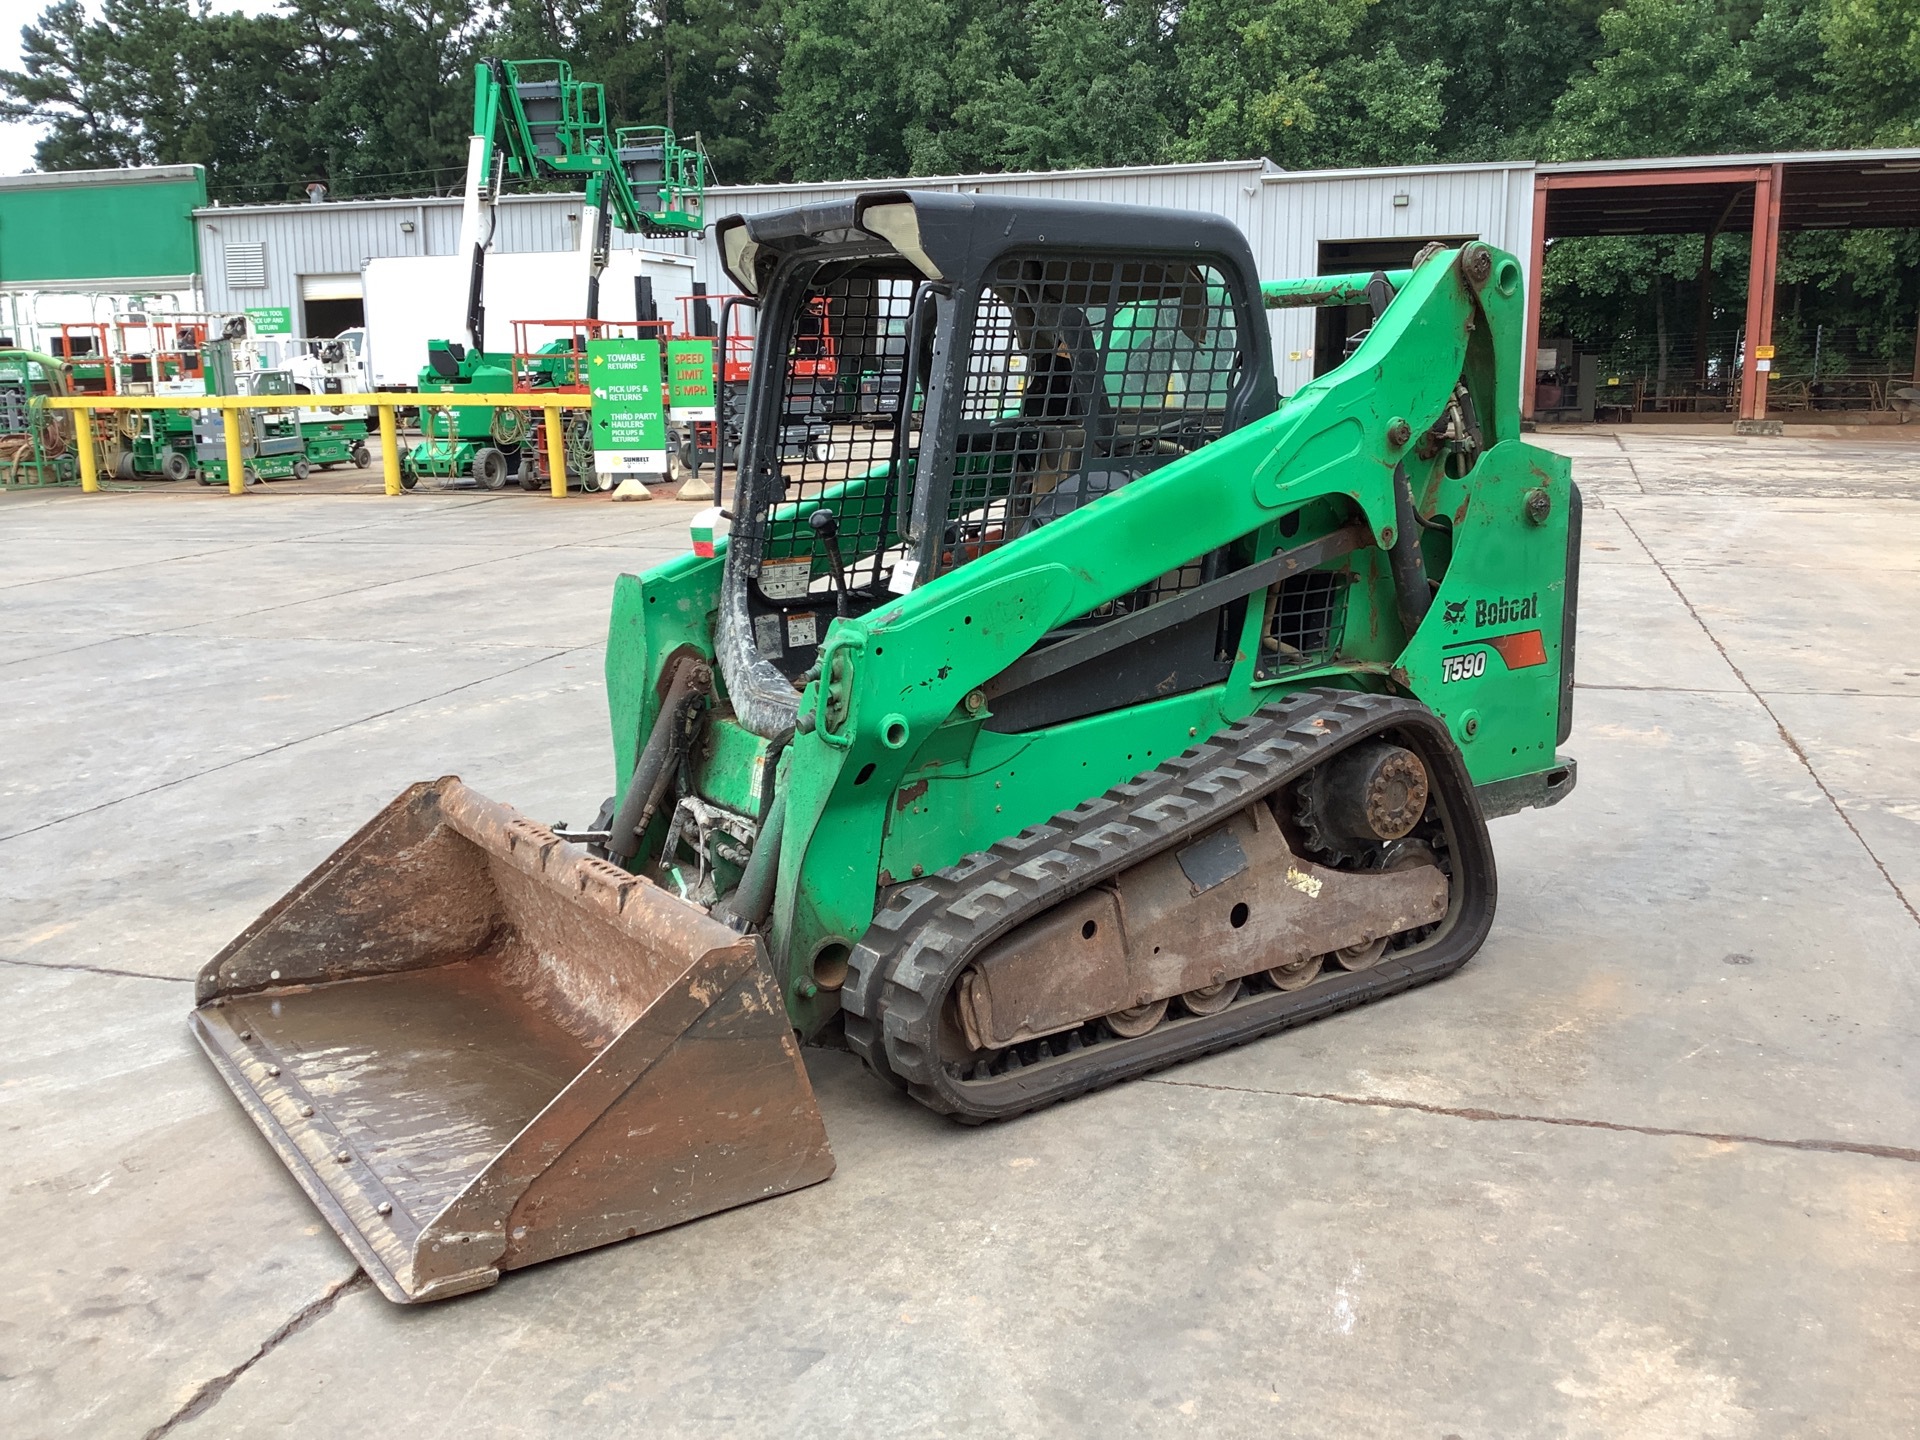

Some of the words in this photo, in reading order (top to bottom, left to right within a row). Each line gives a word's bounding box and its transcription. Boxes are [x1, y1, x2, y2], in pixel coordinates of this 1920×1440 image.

[606, 353, 645, 362] TOWABLE
[675, 353, 705, 364] SPEED
[607, 362, 638, 370] RETURNS
[677, 369, 704, 381] LIMIT
[608, 385, 625, 393] PICK
[642, 384, 649, 392] &
[674, 385, 681, 396] 5
[683, 385, 708, 396] MPH
[609, 393, 643, 401] RETURNS
[634, 412, 657, 420] PARTY
[611, 420, 644, 428] HAULERS
[1475, 592, 1538, 628] Bobcat
[1442, 650, 1487, 684] T590
